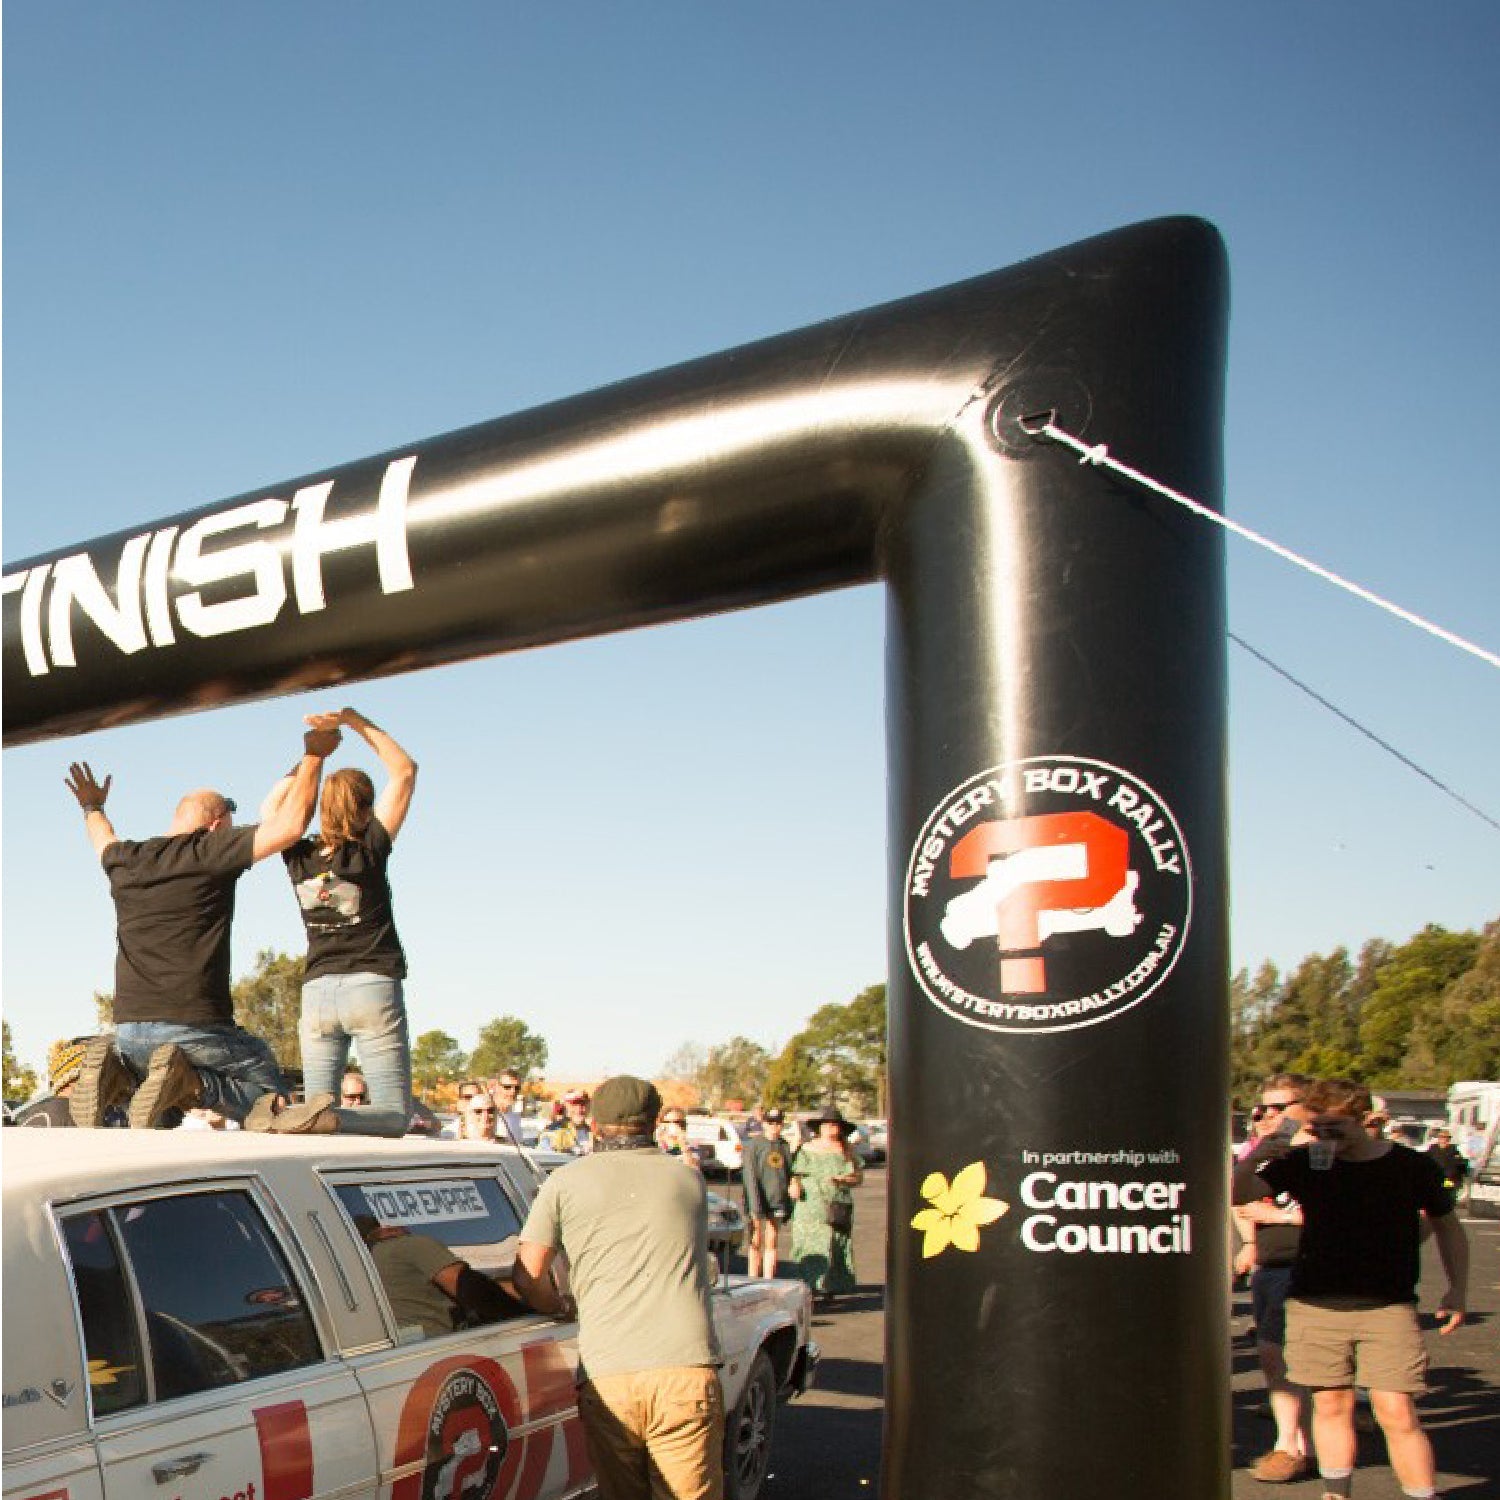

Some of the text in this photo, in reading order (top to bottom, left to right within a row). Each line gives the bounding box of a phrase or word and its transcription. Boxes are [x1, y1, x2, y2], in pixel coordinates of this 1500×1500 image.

[911, 768, 1183, 897] MYSTERY BOX RALLY
[1023, 1150, 1181, 1168] In partnership with
[1020, 1171, 1188, 1211] Cancer
[1020, 1213, 1192, 1255] Council
